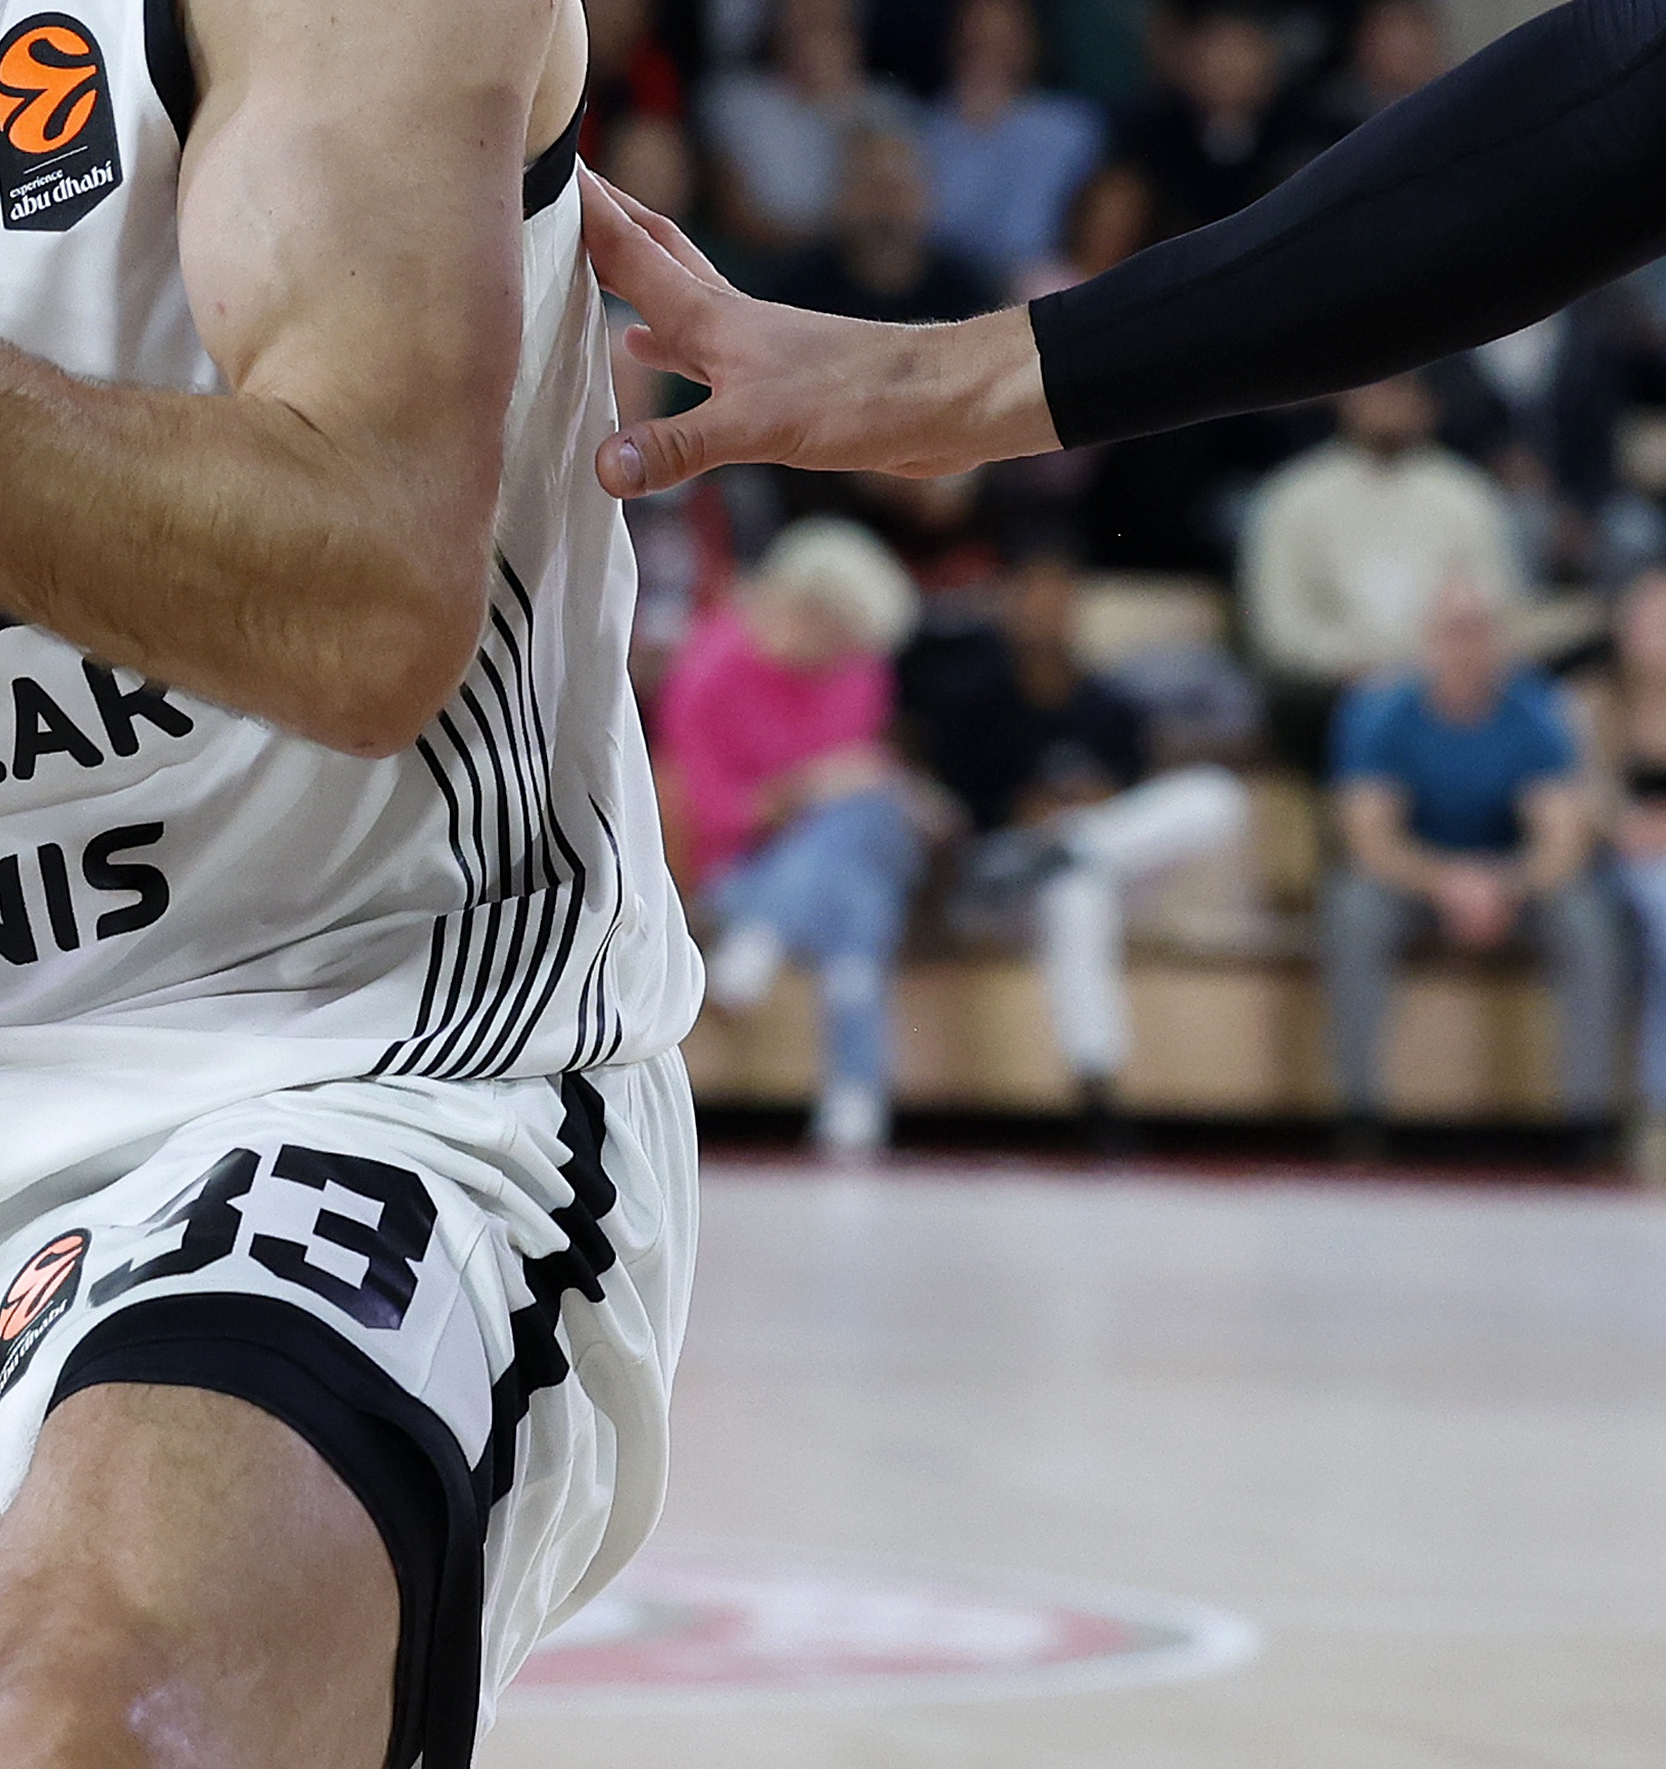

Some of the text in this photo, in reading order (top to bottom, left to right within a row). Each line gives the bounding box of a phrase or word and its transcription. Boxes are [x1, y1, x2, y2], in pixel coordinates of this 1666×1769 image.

[9, 168, 63, 198] experience
[10, 160, 114, 221] abu dhabi
[86, 1144, 438, 1330] 33
